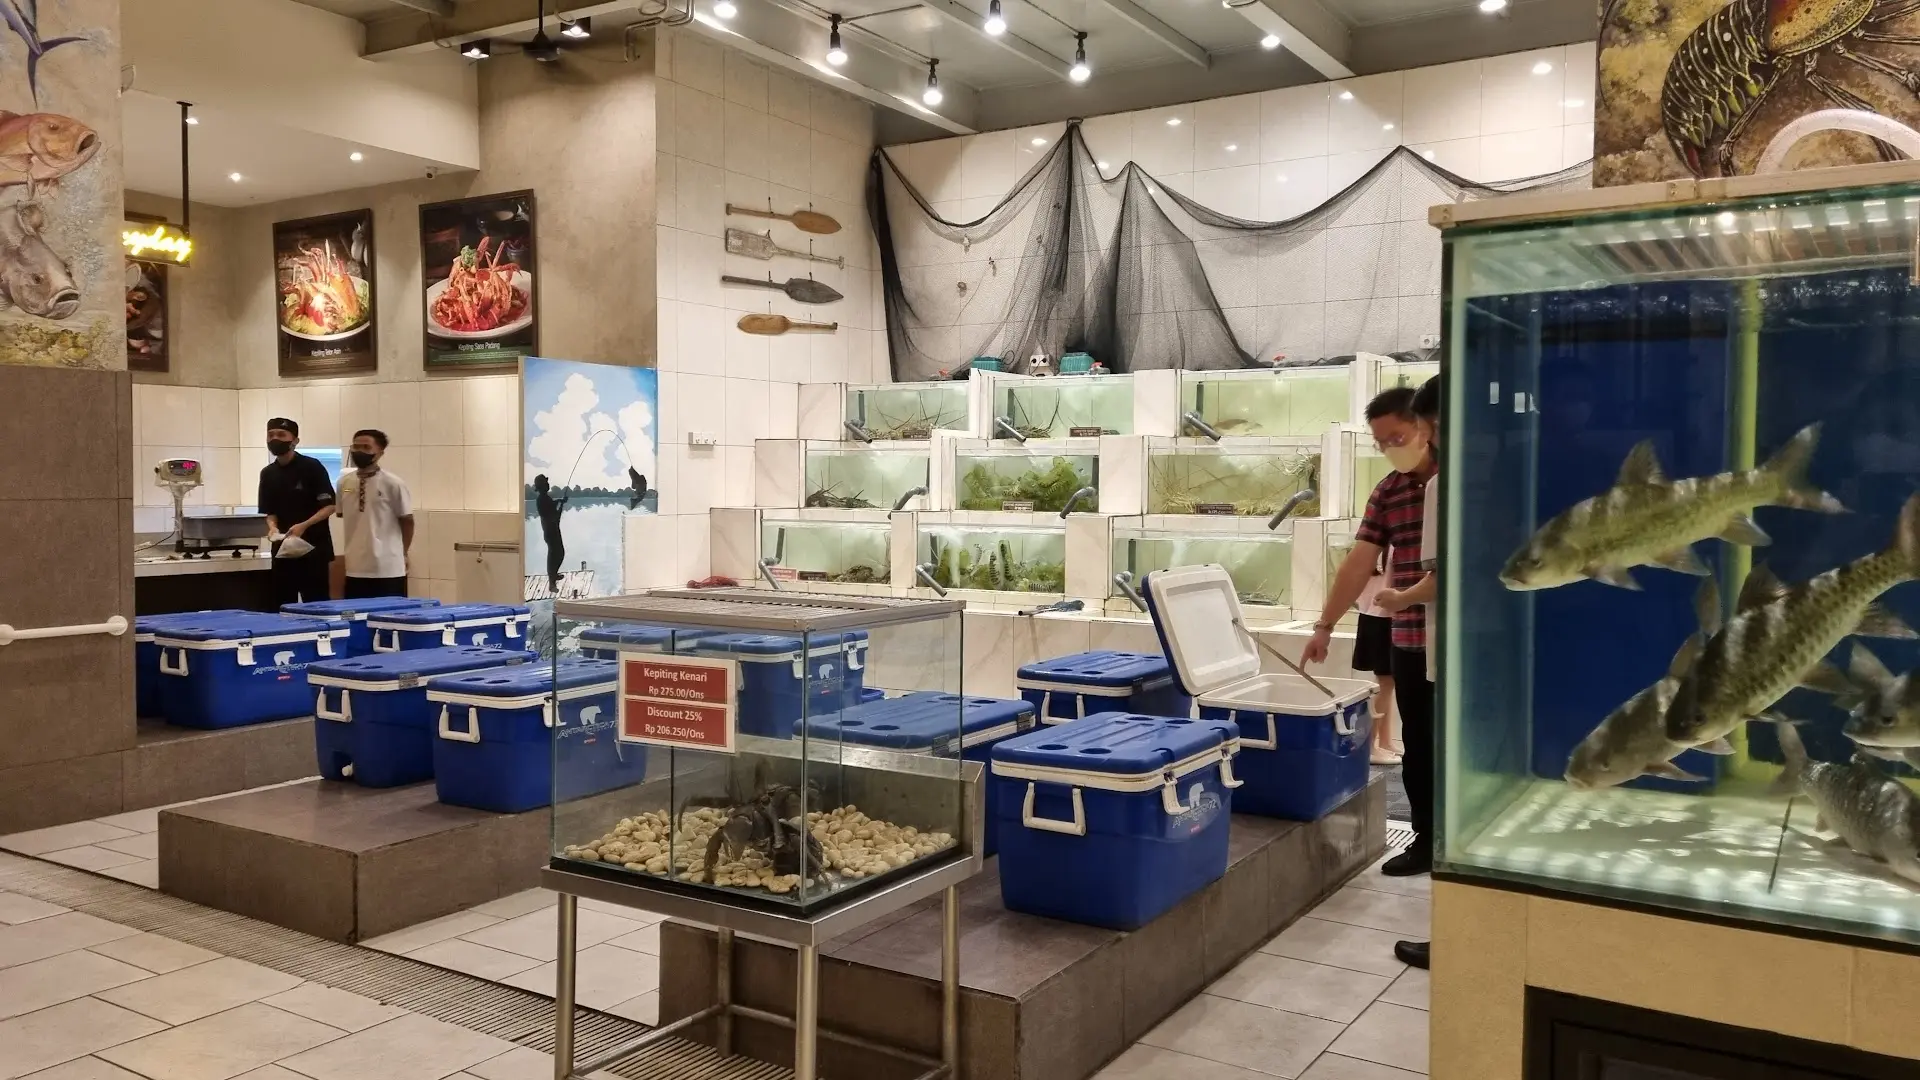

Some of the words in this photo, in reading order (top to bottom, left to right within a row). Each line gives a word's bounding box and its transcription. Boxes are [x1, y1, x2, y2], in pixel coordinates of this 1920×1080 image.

[643, 667, 678, 682] Kepiting
[679, 670, 708, 682] Kenari
[648, 685, 659, 696] Rp
[660, 687, 705, 700] 275.00/Ons
[647, 706, 683, 720] Discount
[684, 710, 703, 722] 25%
[645, 723, 656, 735] Rp
[656, 725, 705, 739] 206.250/Ons
